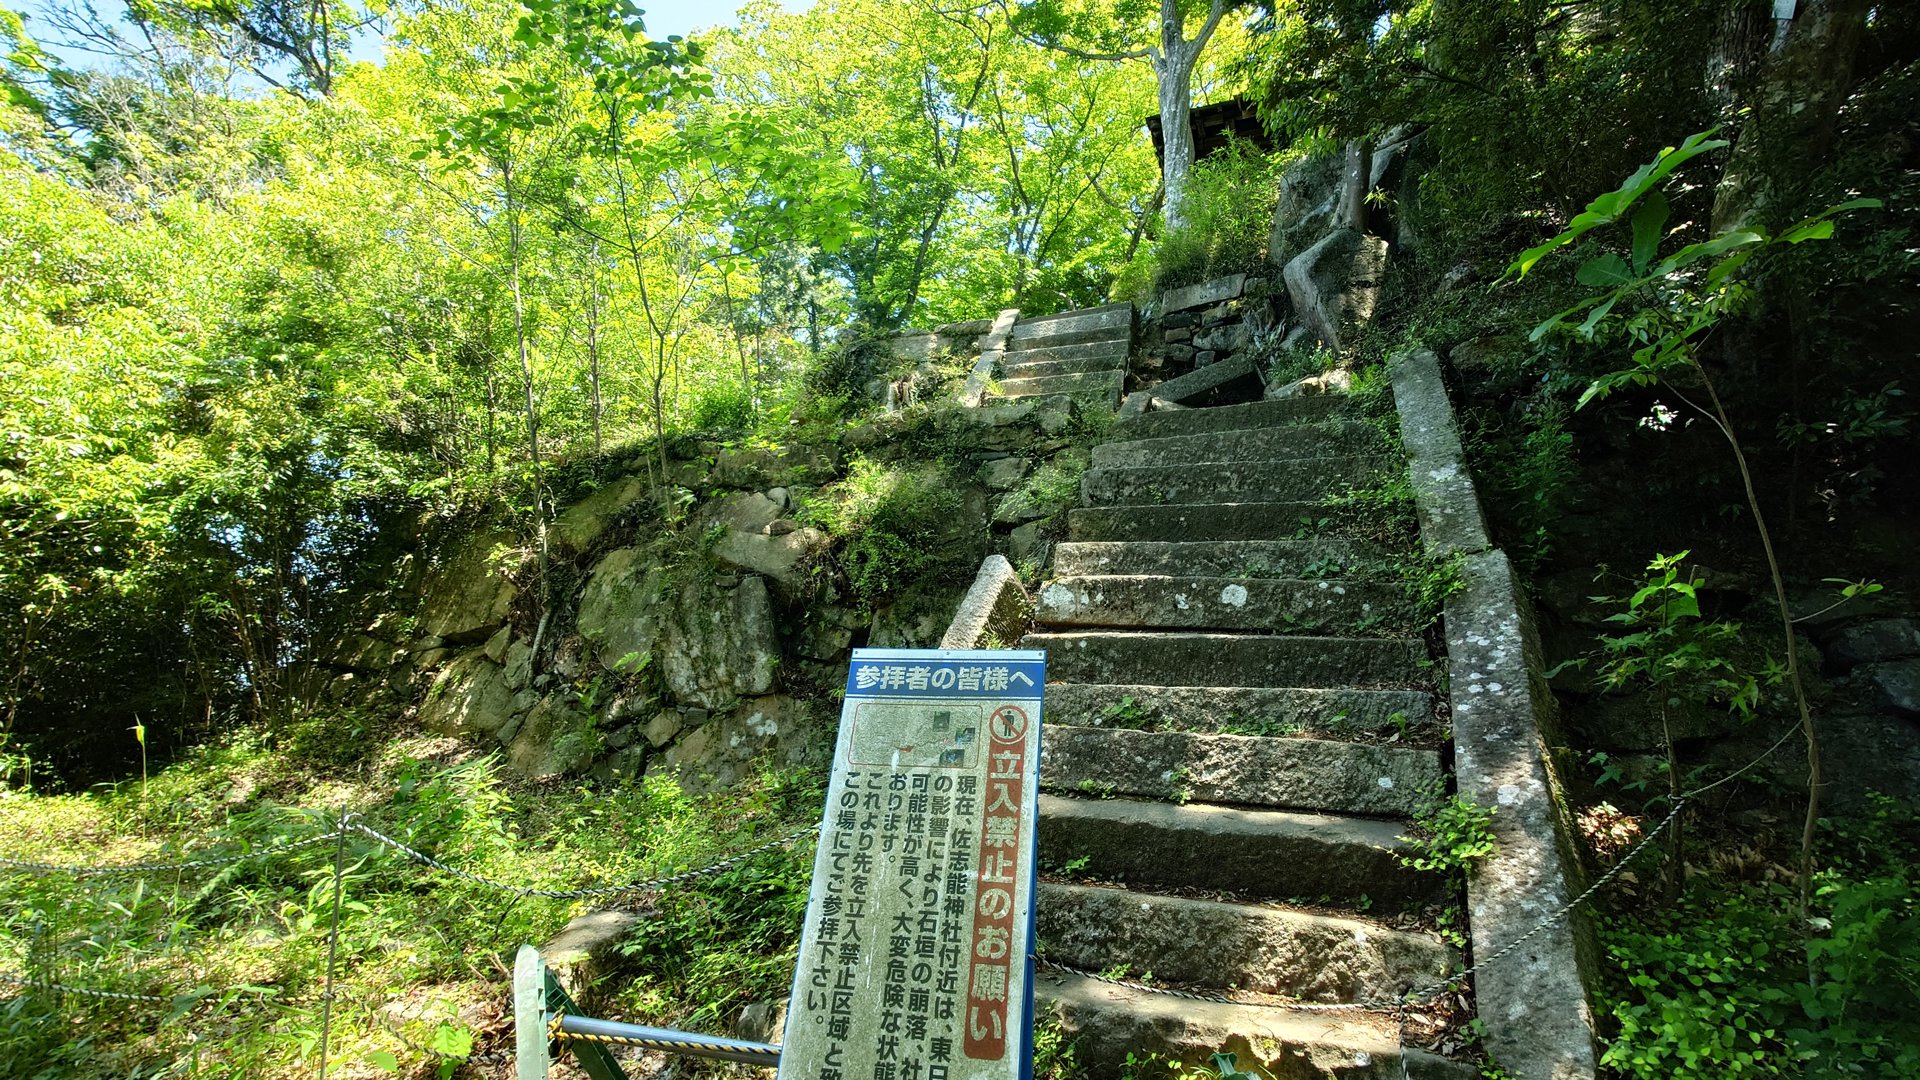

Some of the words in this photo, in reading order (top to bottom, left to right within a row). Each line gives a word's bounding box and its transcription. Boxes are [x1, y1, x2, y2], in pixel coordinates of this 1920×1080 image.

[856, 665, 1034, 690] 参拝者の皆様へ
[807, 772, 860, 1024] この場にてご参拝下さい。
[881, 773, 906, 863] おります。
[900, 776, 952, 1080] の影響により石垣の崩落、社
[968, 750, 1021, 1041] 立入禁止のお願い
